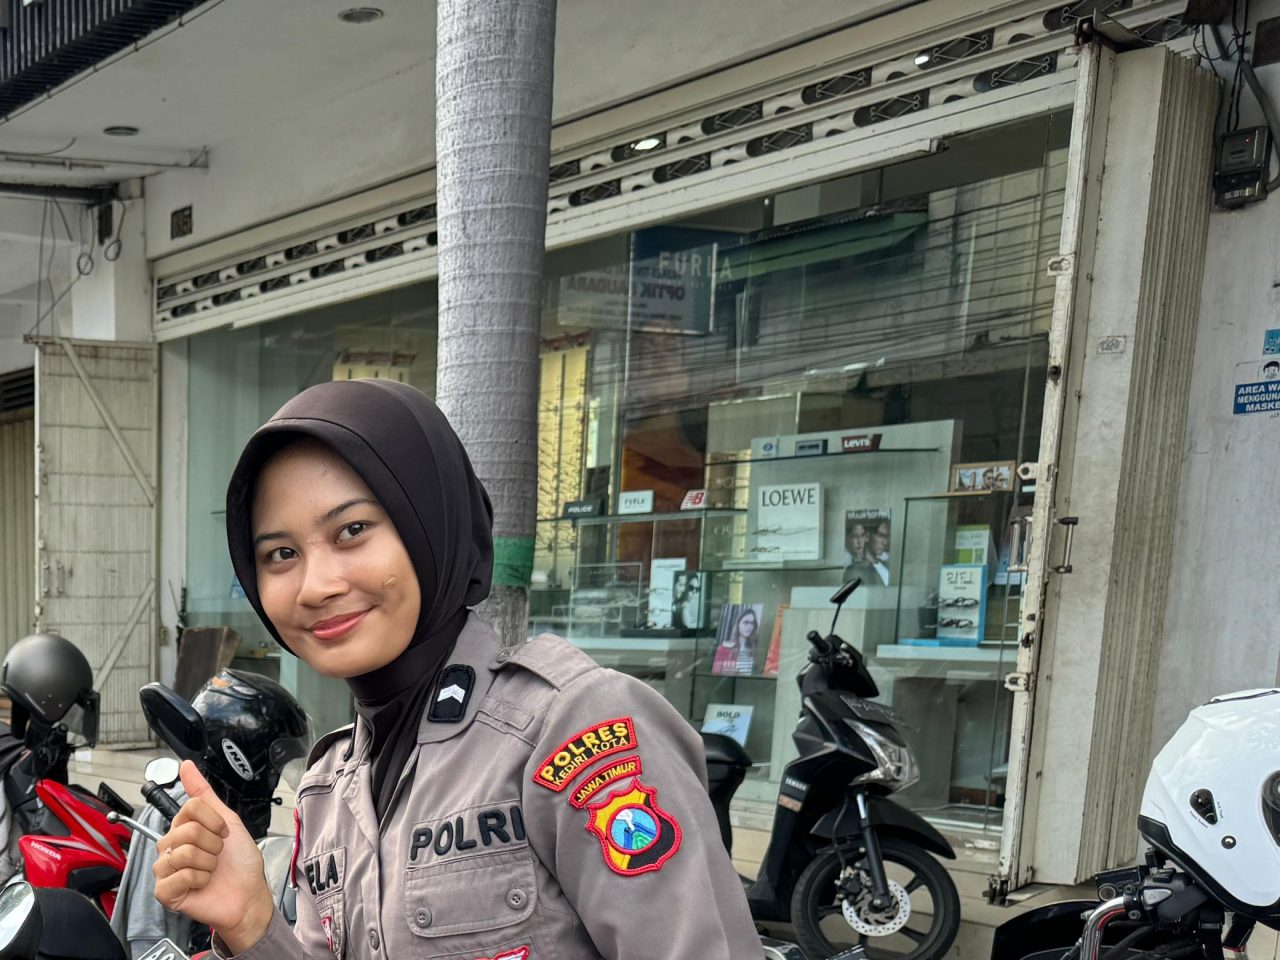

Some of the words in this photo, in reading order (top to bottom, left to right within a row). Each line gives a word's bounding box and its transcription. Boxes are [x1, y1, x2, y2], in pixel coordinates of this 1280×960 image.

[1238, 385, 1265, 395] AREA
[567, 504, 593, 514] POLICE
[762, 488, 816, 507] LOEWE
[224, 744, 251, 776] INK
[540, 722, 629, 782] POLRES
[552, 754, 588, 786] KEDIRI
[591, 738, 629, 756] KOTA
[577, 776, 605, 803] JAWA
[602, 761, 637, 781] TIMUR
[409, 807, 527, 862] POLRI
[303, 855, 339, 895] ELA
